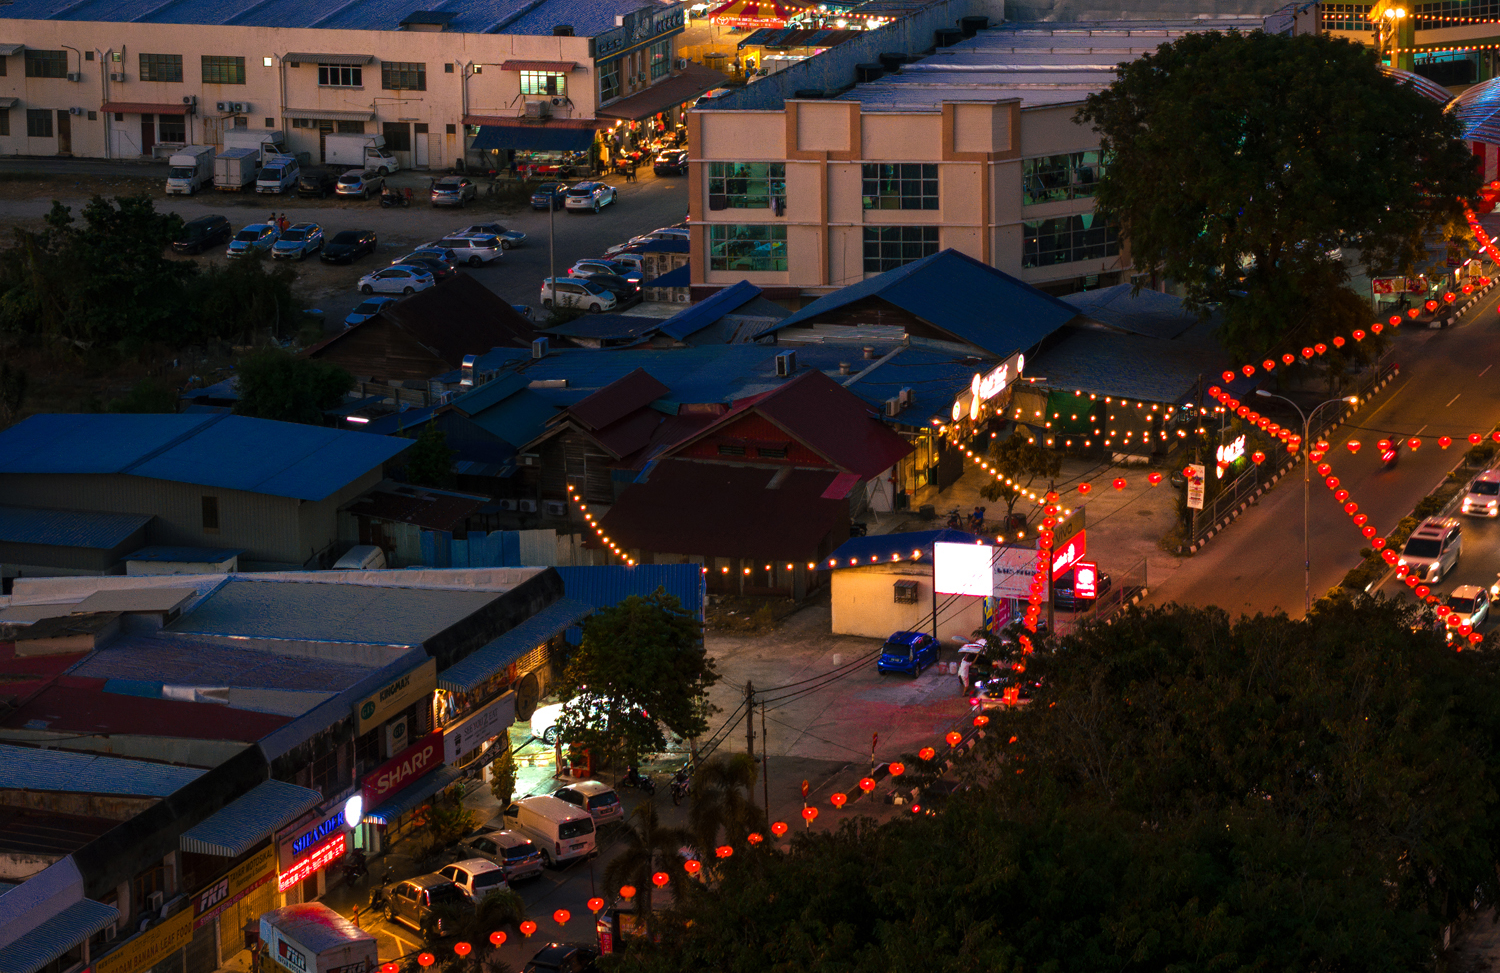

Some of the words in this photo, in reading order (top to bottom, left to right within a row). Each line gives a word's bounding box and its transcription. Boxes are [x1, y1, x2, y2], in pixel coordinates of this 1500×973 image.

[379, 675, 410, 703] KINGMAX
[376, 745, 434, 795] SHARP
[133, 943, 159, 967] BANANA
[160, 932, 175, 950] LEAF
[176, 921, 192, 940] FOOD
